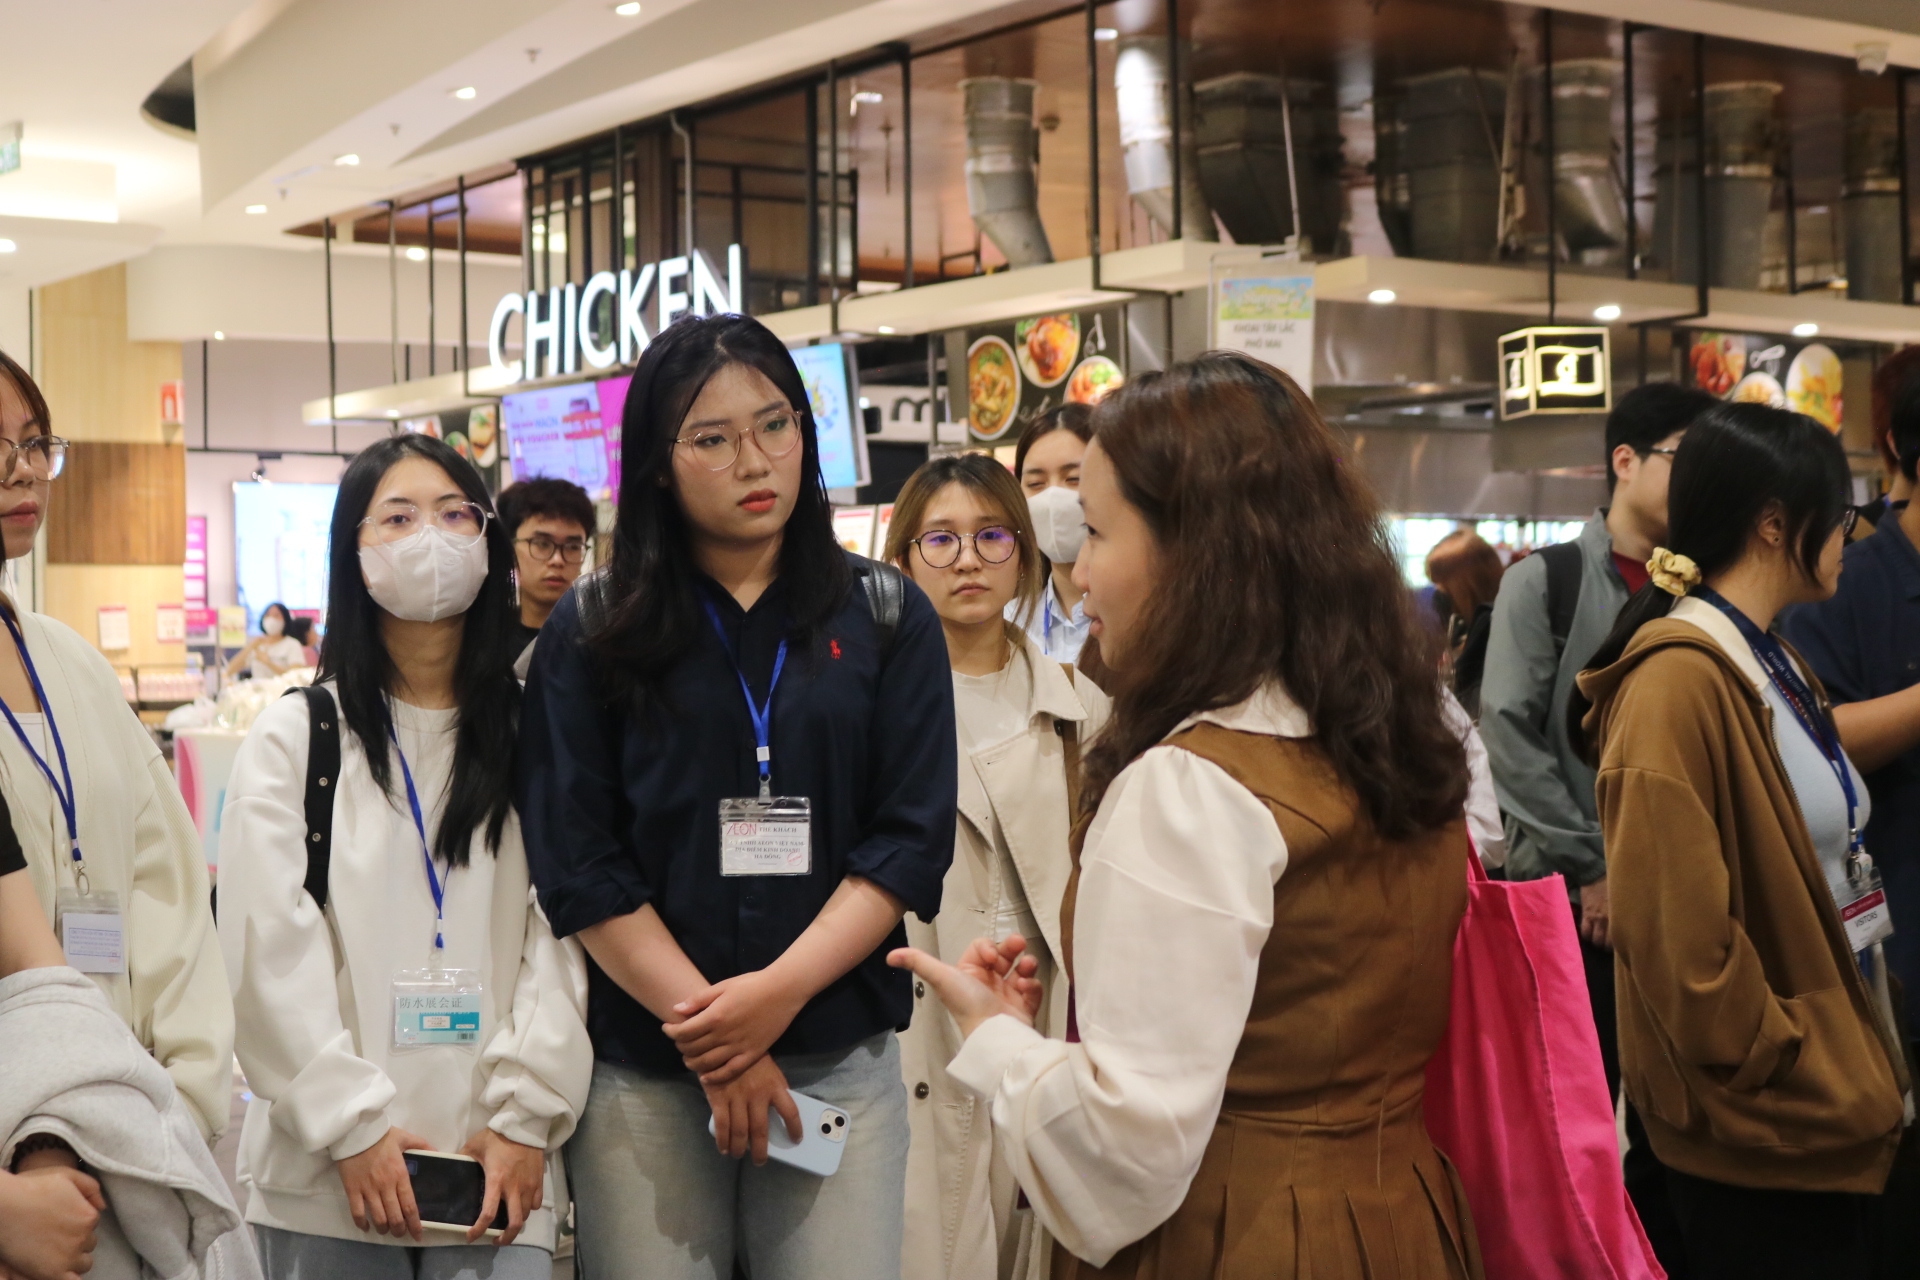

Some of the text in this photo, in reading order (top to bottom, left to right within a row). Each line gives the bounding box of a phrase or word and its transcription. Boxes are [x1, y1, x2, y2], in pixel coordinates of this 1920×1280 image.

[489, 243, 742, 388] CHICKEN
[1767, 651, 1786, 673] WORLD
[1854, 911, 1878, 928] VISITORS
[399, 996, 463, 1009] 防水展会证
